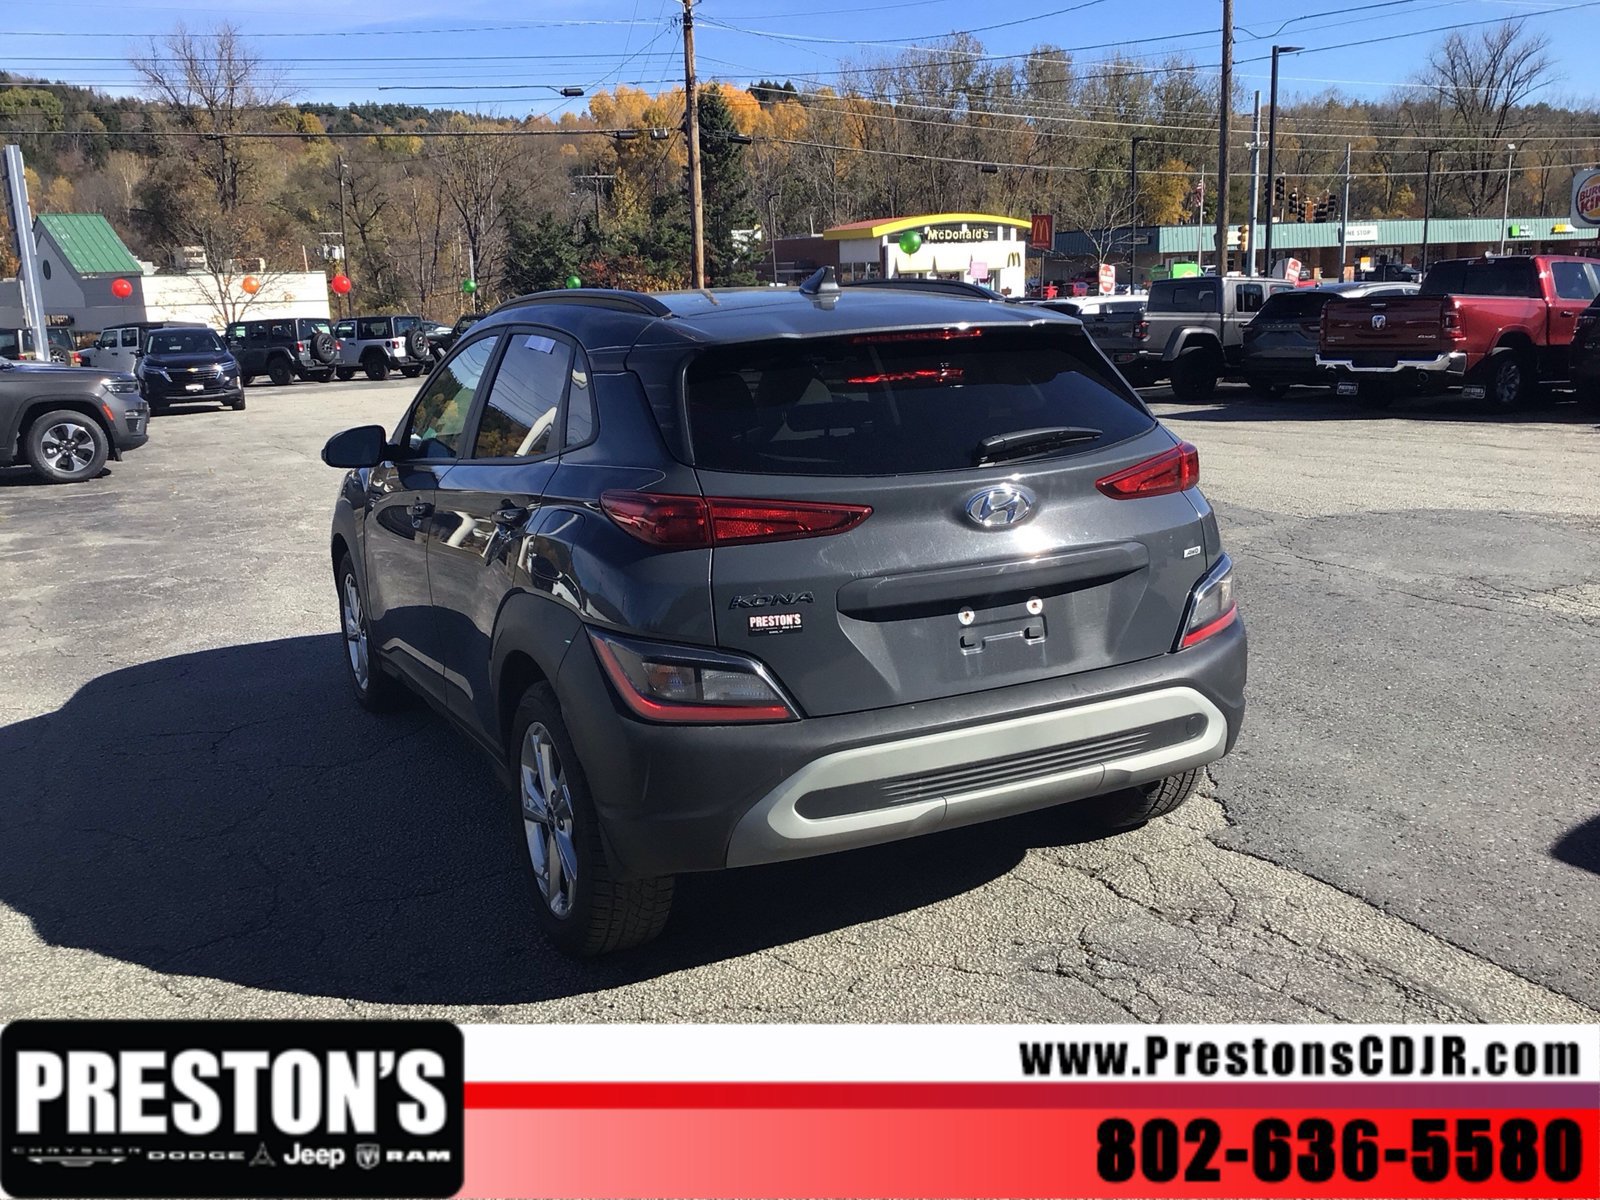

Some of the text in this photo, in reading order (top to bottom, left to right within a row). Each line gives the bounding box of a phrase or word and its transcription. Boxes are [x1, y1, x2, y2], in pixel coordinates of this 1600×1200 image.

[927, 228, 989, 240] McDonald's
[729, 591, 814, 609] KONA
[749, 613, 802, 628] PRESTON'S
